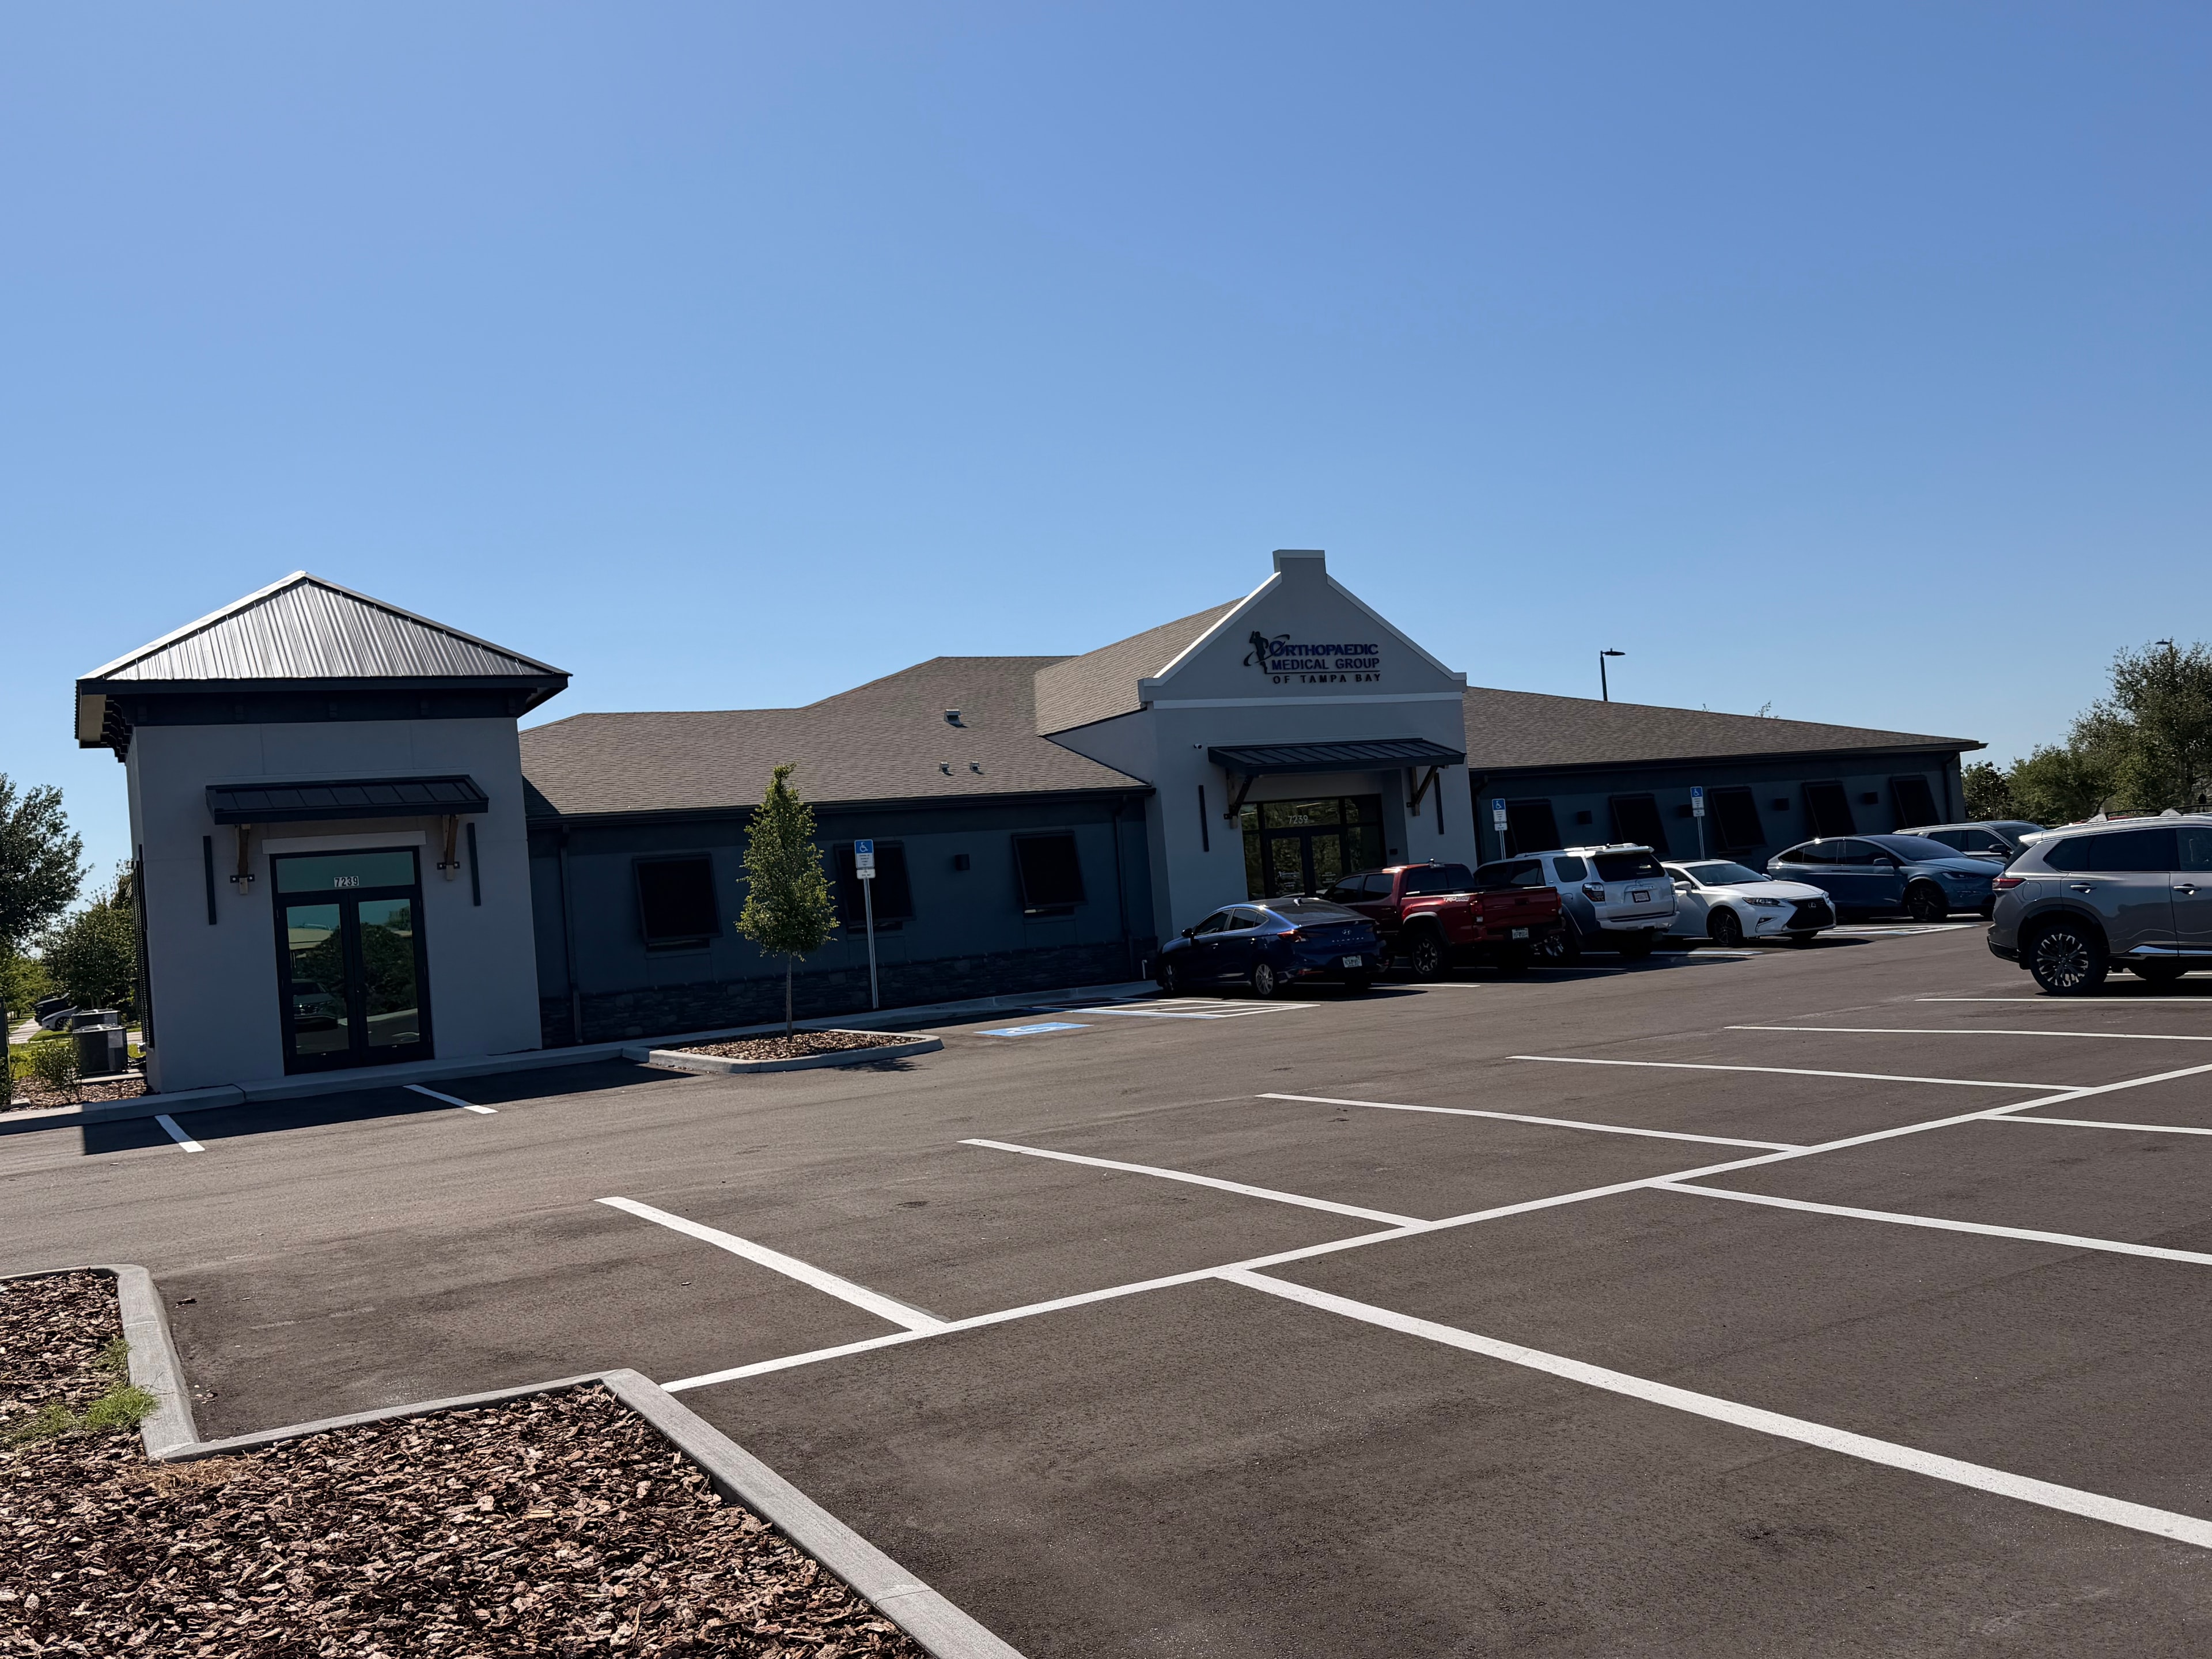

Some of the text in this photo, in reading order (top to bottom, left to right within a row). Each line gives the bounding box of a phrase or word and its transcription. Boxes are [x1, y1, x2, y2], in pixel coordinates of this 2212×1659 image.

[1270, 641, 1378, 656] ORTHOPAEDIC
[1272, 658, 1380, 670] MEDICAL GROUP
[1273, 674, 1380, 684] OF TAMPA BAY
[1288, 815, 1309, 824] 7239
[335, 877, 358, 887] 7239
